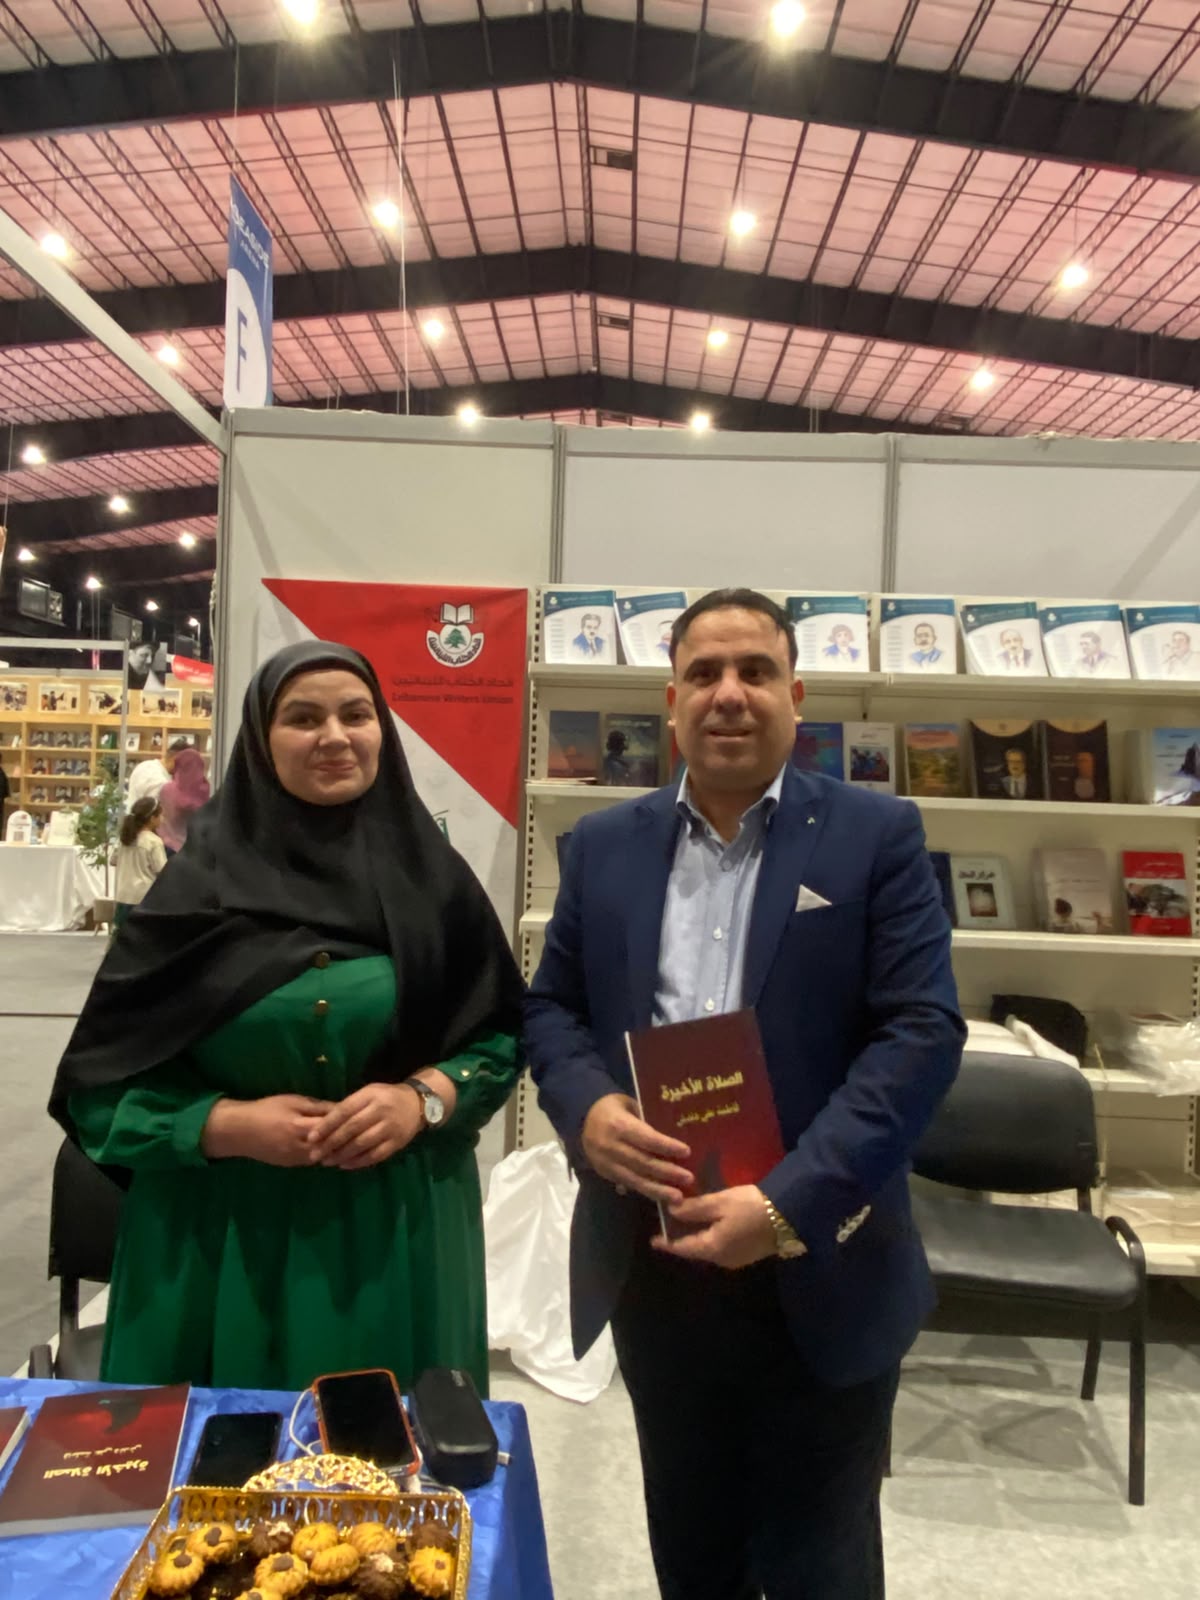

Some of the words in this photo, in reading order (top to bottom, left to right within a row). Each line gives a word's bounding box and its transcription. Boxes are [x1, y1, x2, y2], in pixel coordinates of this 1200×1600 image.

[237, 307, 248, 393] F
[661, 1078, 702, 1102] الأخيرة
[706, 1071, 743, 1090] الصلاة
[43, 1467, 92, 1479] الصلاة
[96, 1459, 149, 1476] الأخيرة
